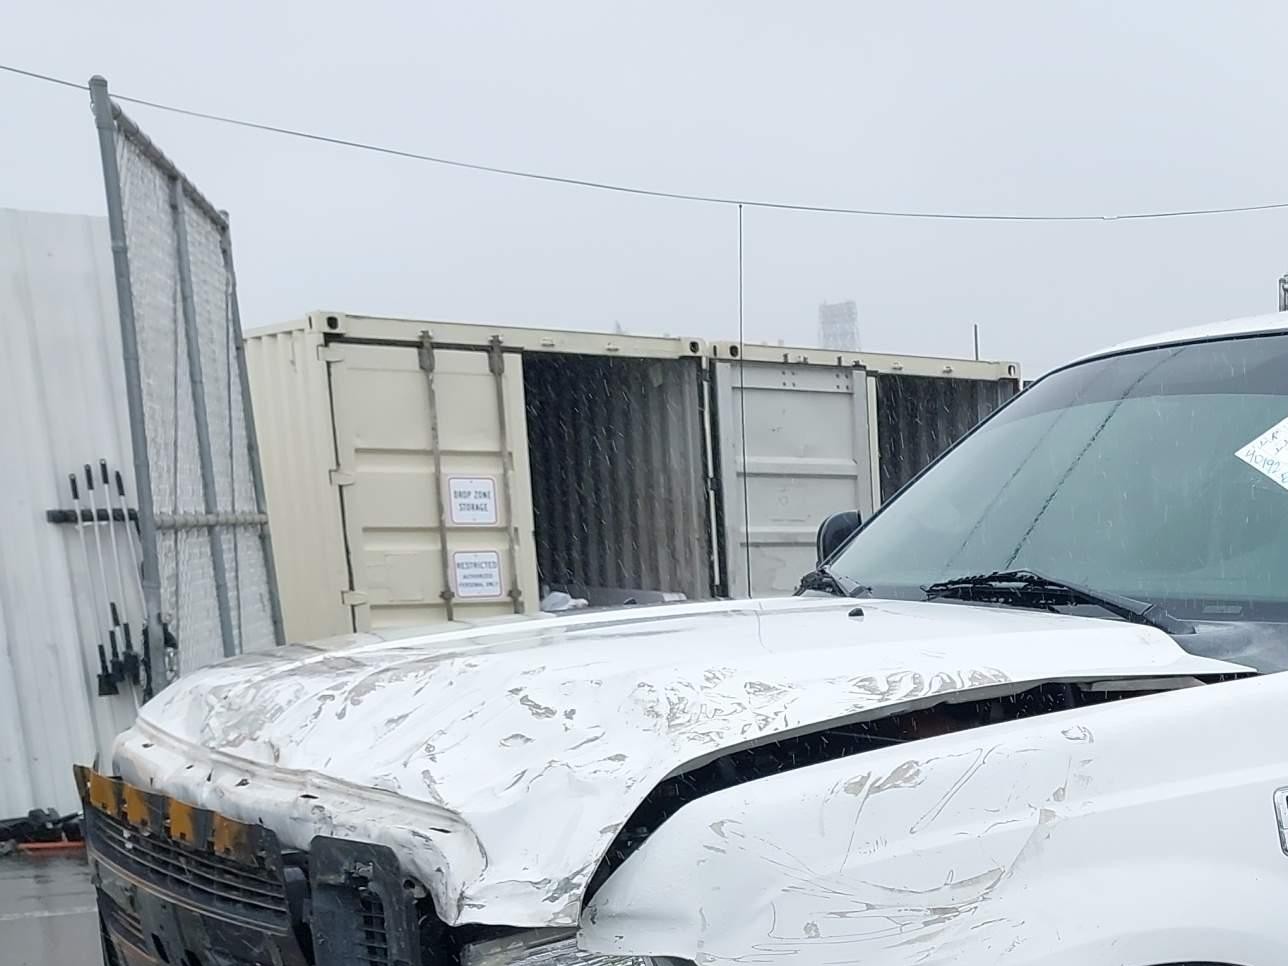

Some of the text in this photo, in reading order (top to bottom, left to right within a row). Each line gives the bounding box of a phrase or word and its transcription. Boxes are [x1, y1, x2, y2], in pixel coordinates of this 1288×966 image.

[453, 490, 491, 499] DROP ZONE
[458, 503, 488, 512] STORAGE
[456, 560, 497, 569] RESTRICTED
